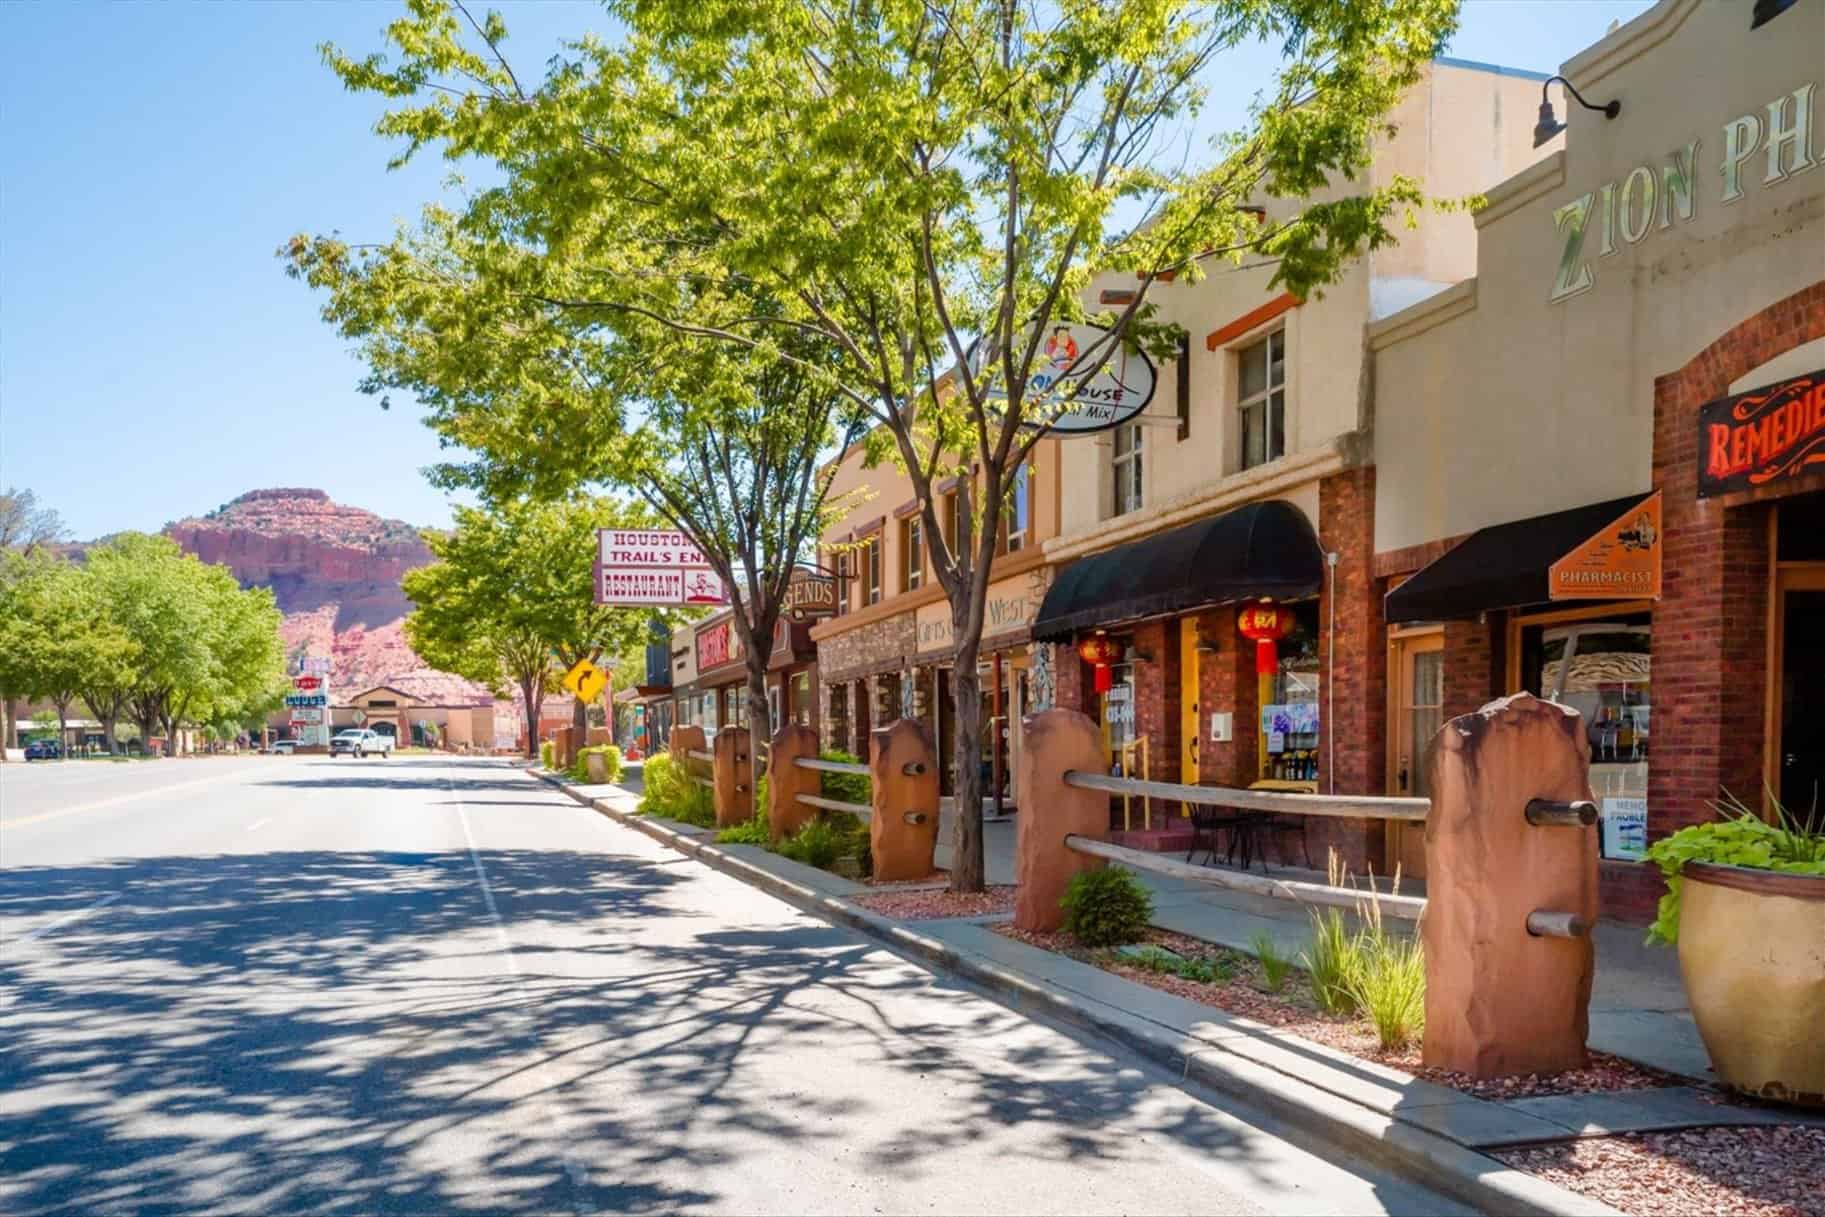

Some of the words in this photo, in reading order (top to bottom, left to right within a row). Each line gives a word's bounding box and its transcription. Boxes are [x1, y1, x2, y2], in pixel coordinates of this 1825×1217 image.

[1550, 137, 1702, 304] ZION
[1719, 80, 1825, 206] PH
[1087, 405, 1112, 419] Mix
[610, 550, 673, 563] TRAIL'S
[679, 551, 706, 564] EN
[1560, 571, 1652, 584] PHARMACIST
